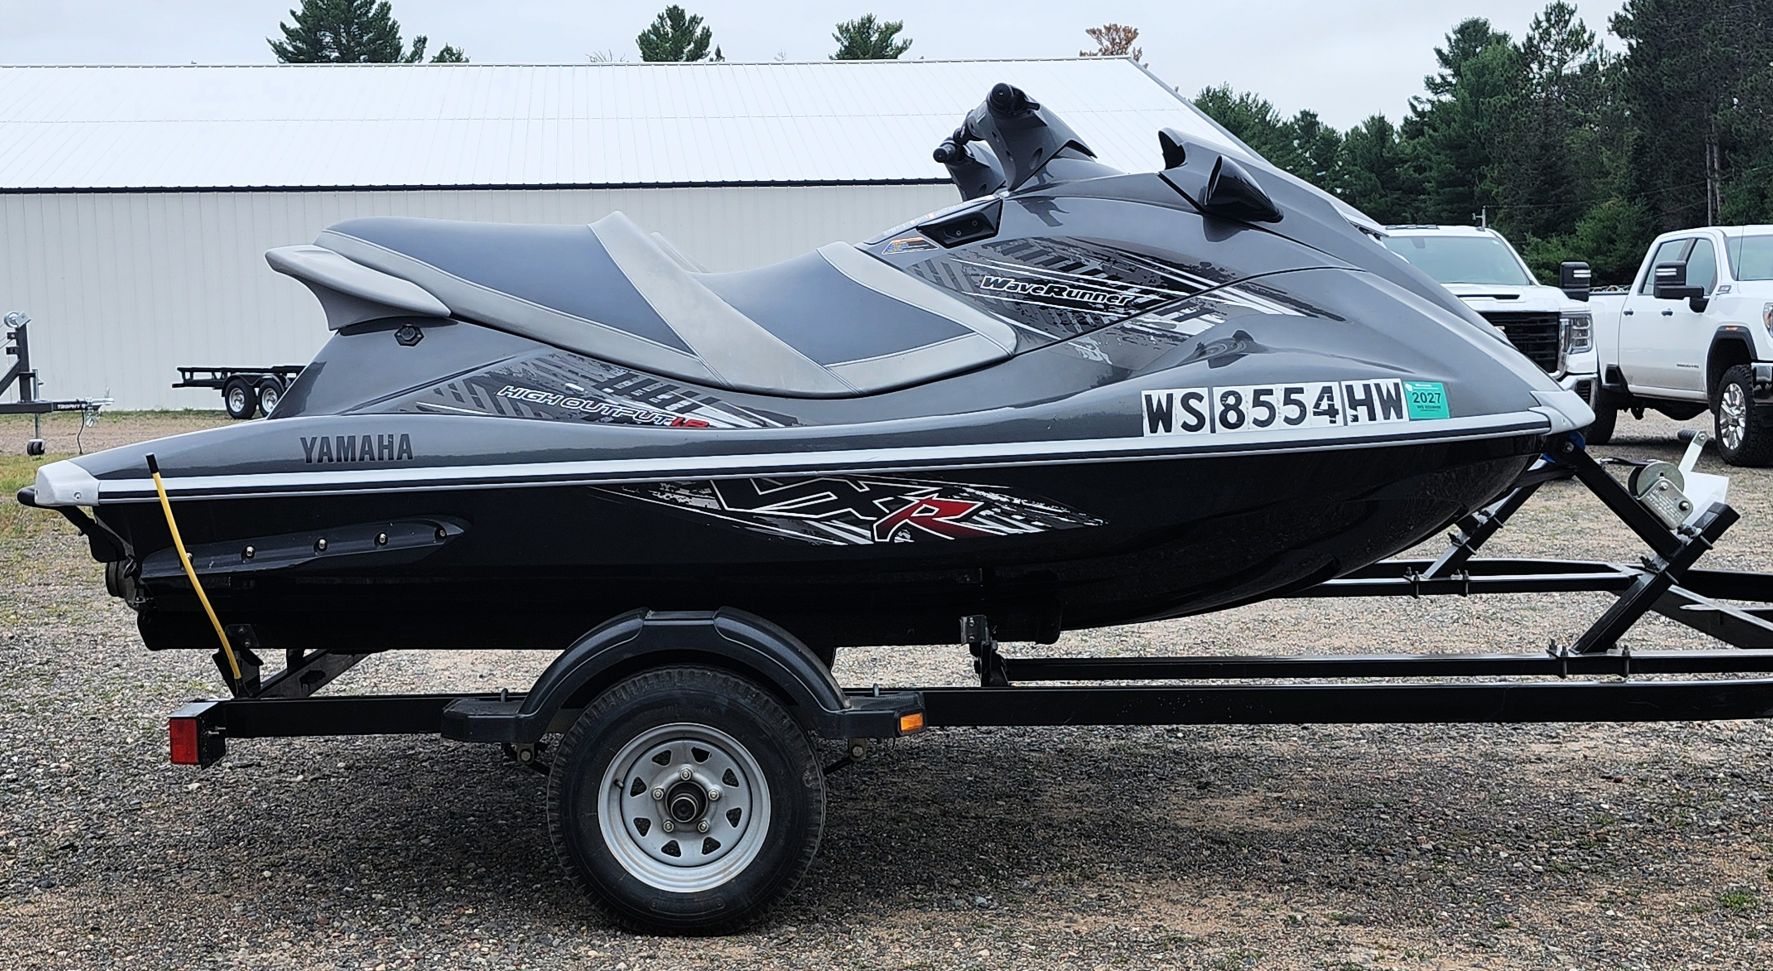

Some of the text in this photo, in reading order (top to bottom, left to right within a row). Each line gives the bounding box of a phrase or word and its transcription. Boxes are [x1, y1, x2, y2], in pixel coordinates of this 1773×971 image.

[980, 275, 1132, 306] WaveRunner
[495, 385, 563, 405] HIGH
[561, 397, 674, 426] OUTPUT
[1144, 382, 1404, 433] WS 8554 HW
[1412, 392, 1441, 403] 2027
[300, 433, 413, 463] YAMAHA
